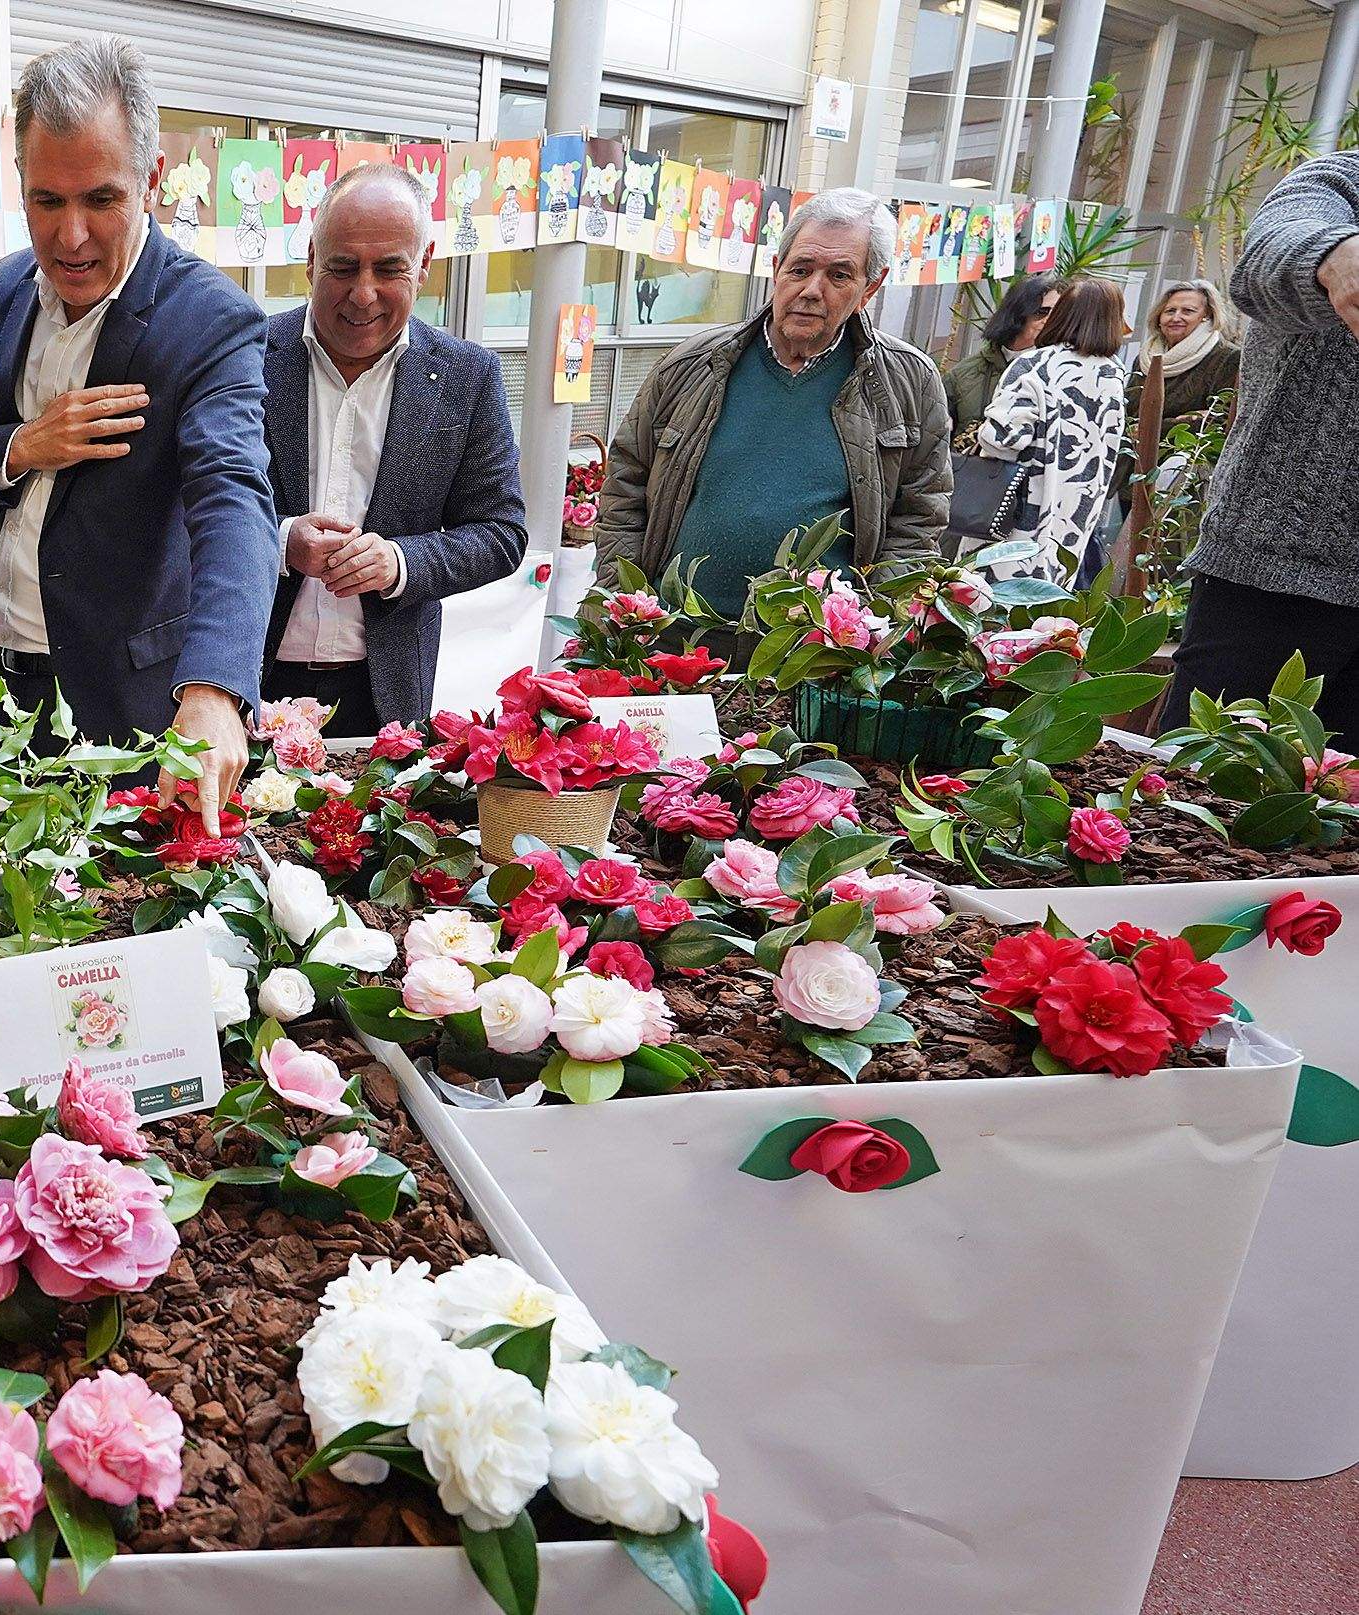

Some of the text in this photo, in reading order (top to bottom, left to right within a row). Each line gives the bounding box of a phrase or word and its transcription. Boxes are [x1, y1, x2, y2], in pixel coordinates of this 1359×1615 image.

[626, 707, 665, 718] CAMELIA
[57, 965, 121, 989] CAMELIA
[20, 1072, 64, 1088] Amigos
[125, 1056, 140, 1068] da
[142, 1047, 186, 1064] Camelia
